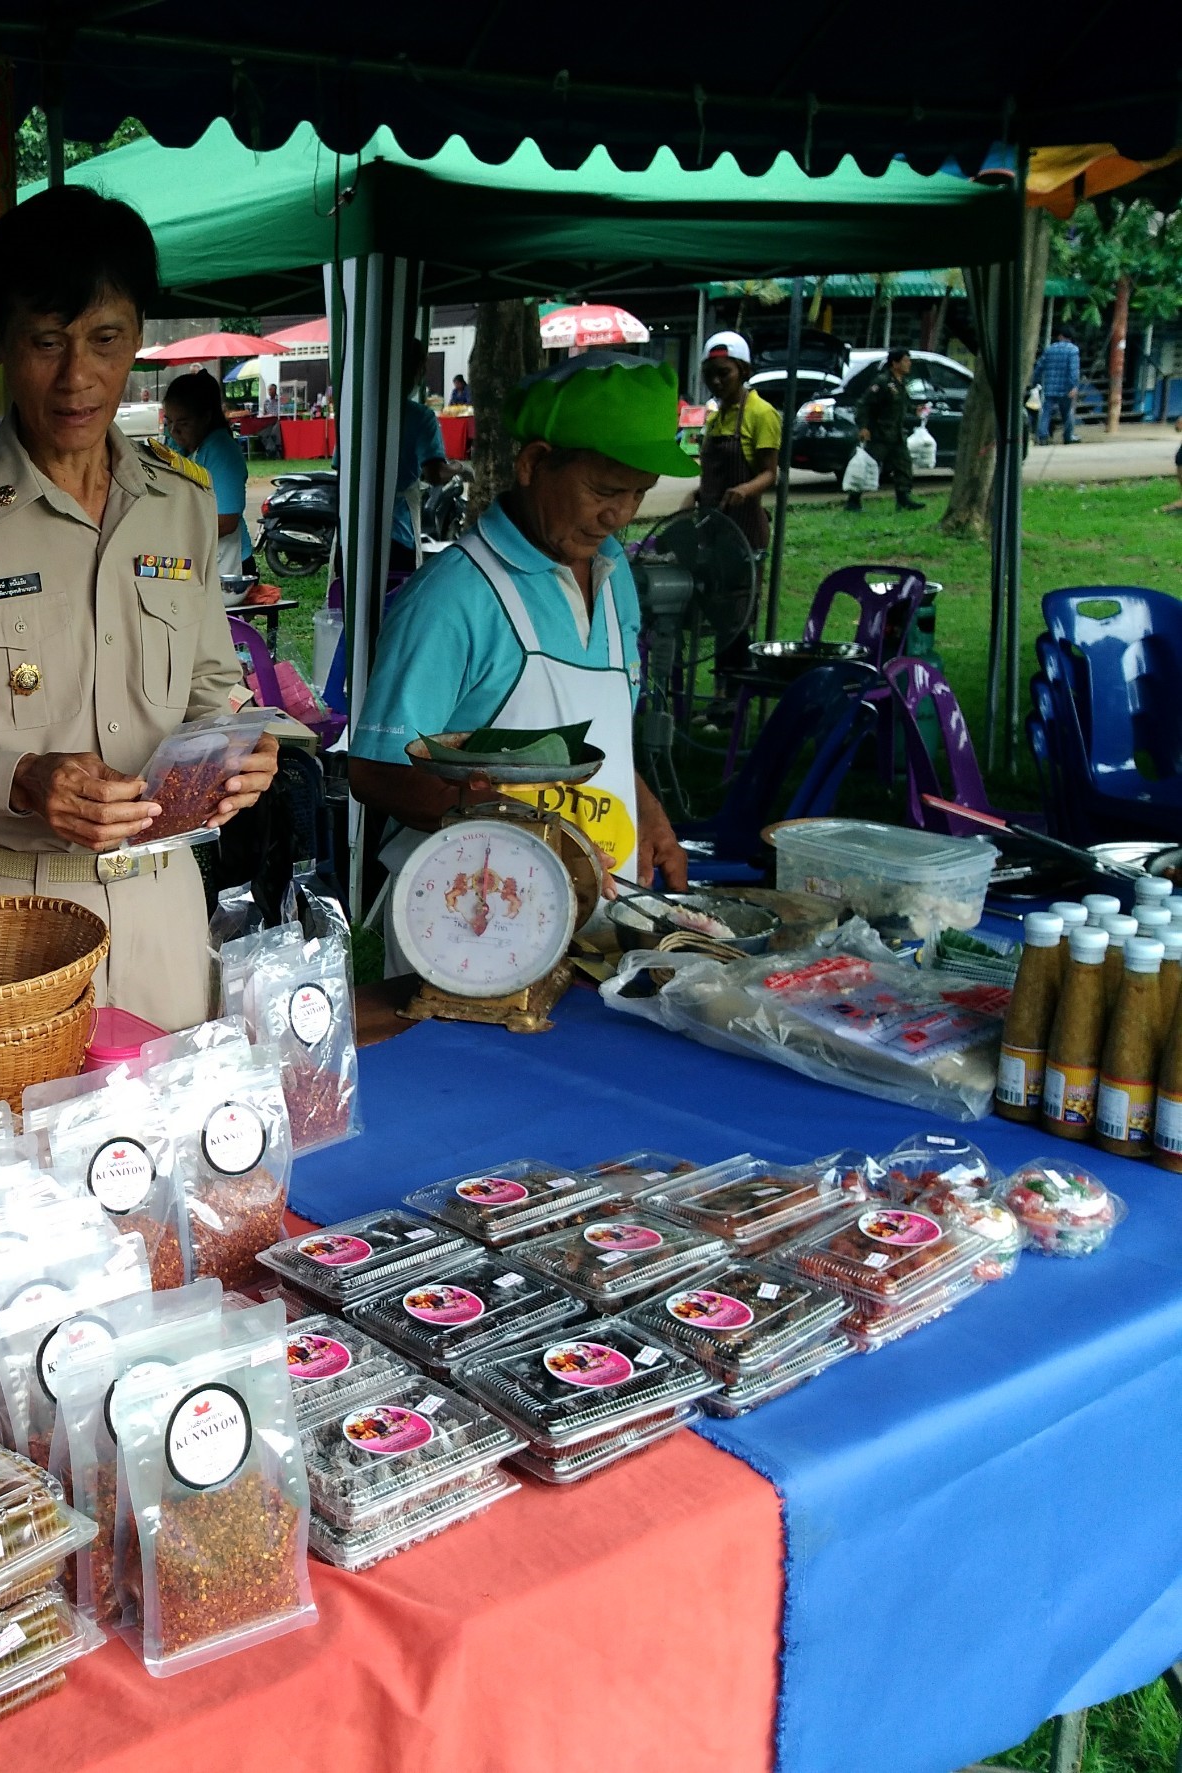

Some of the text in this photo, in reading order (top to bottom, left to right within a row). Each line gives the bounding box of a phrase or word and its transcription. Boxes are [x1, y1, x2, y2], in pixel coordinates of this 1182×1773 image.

[425, 879, 435, 891] 6
[424, 926, 434, 939] 5
[460, 957, 469, 970] 4
[507, 952, 517, 965] 3
[96, 1166, 146, 1180] KUNNIYOM
[175, 1414, 239, 1451] KUNNIYOM
